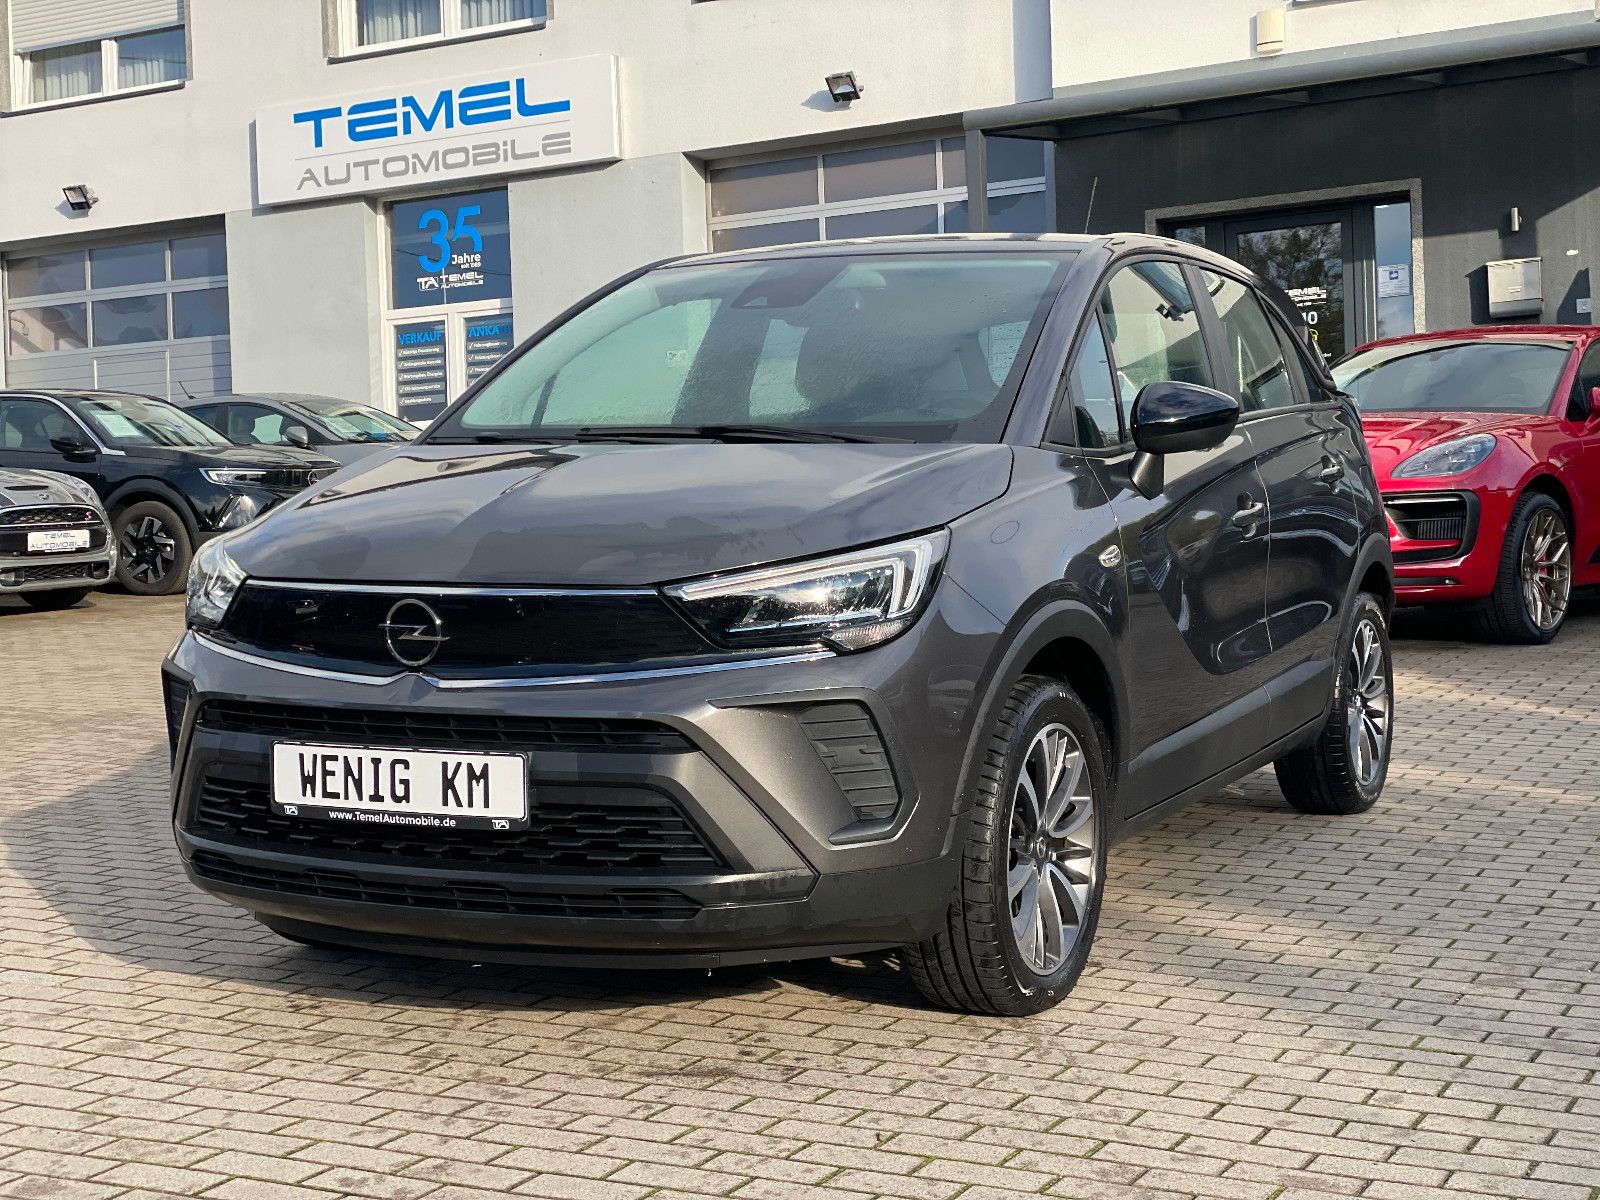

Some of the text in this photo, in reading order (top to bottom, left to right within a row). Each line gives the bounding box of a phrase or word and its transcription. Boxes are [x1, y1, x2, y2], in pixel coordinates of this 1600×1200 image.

[293, 77, 571, 149] TEMEL
[418, 205, 483, 273] 35
[451, 252, 482, 265] Jahre
[440, 271, 484, 282] TEMEL
[398, 330, 443, 345] VERKAUF
[298, 752, 490, 809] WENIG KM
[328, 810, 457, 828] www.TemelAutomobile.de
